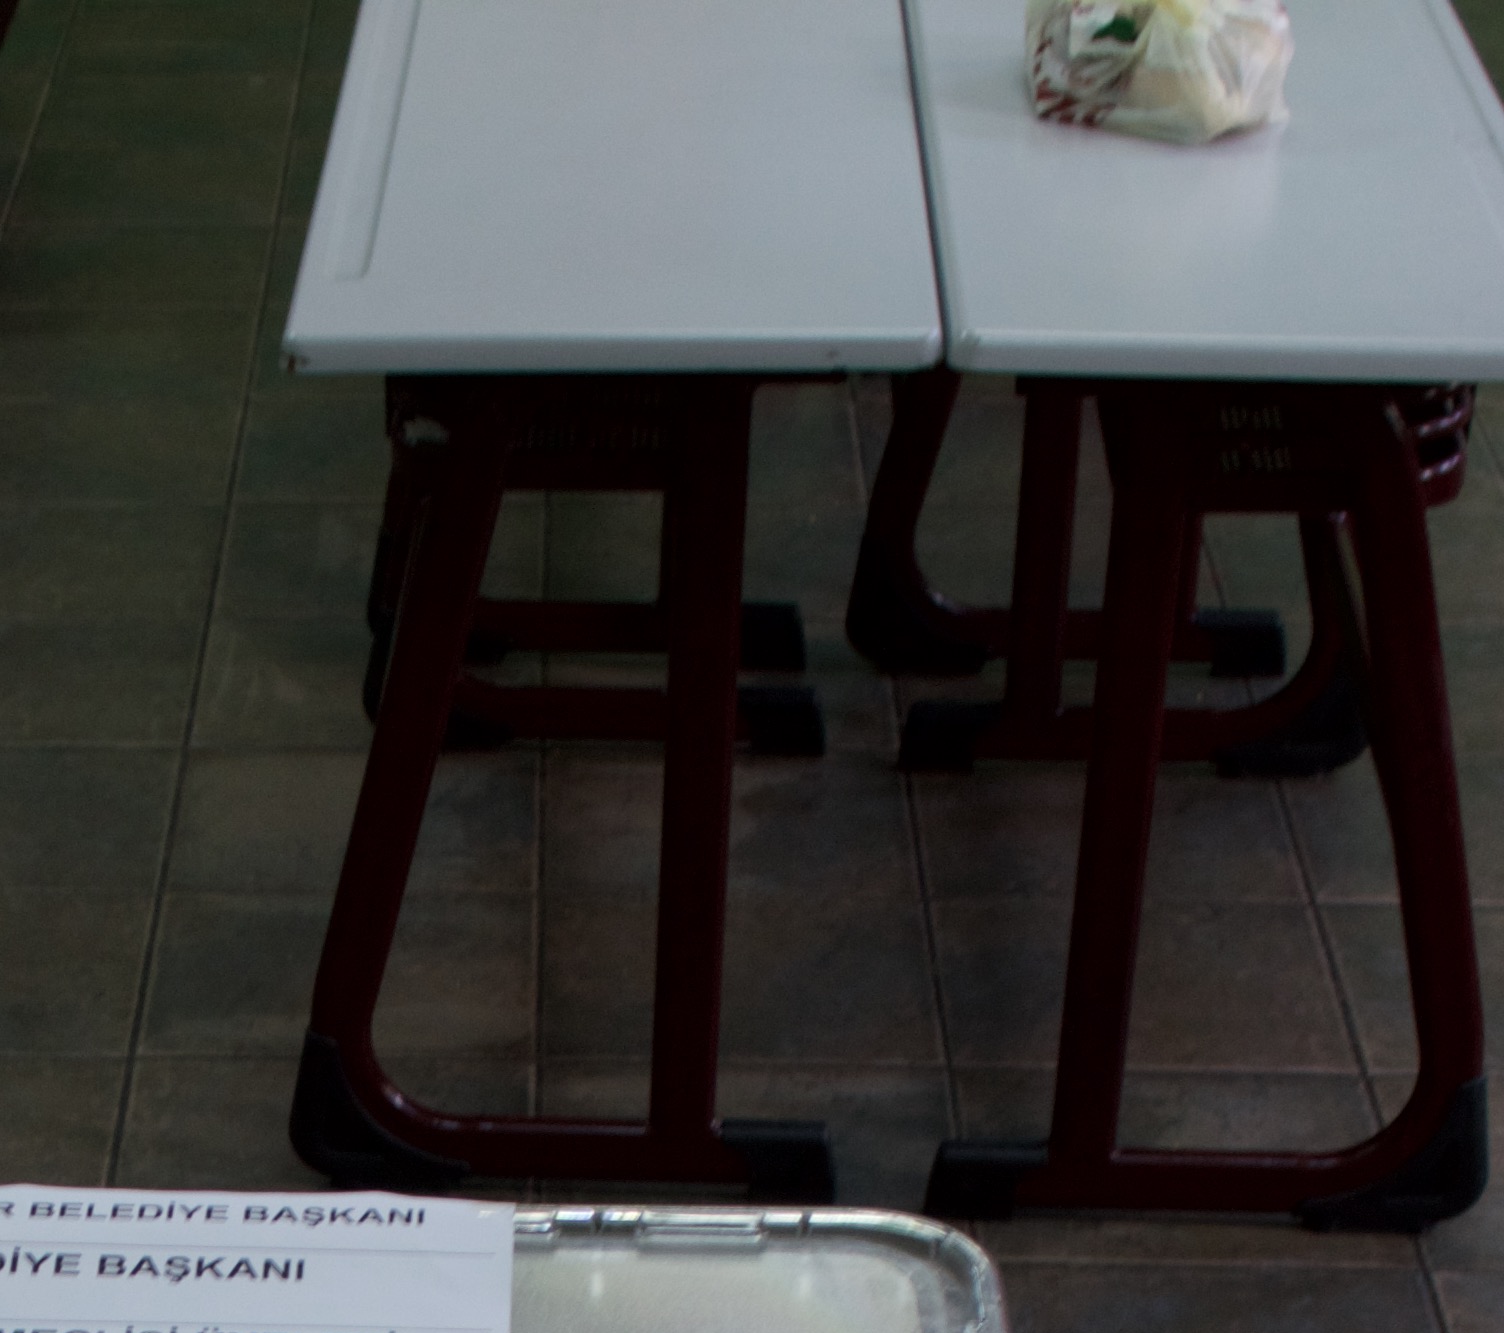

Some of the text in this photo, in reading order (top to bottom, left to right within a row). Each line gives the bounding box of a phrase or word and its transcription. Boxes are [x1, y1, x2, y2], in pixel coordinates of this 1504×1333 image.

[28, 1200, 230, 1221] BELEDİYE
[241, 1205, 426, 1227] BAŞKANI
[95, 1254, 306, 1284] BAŞKANI
